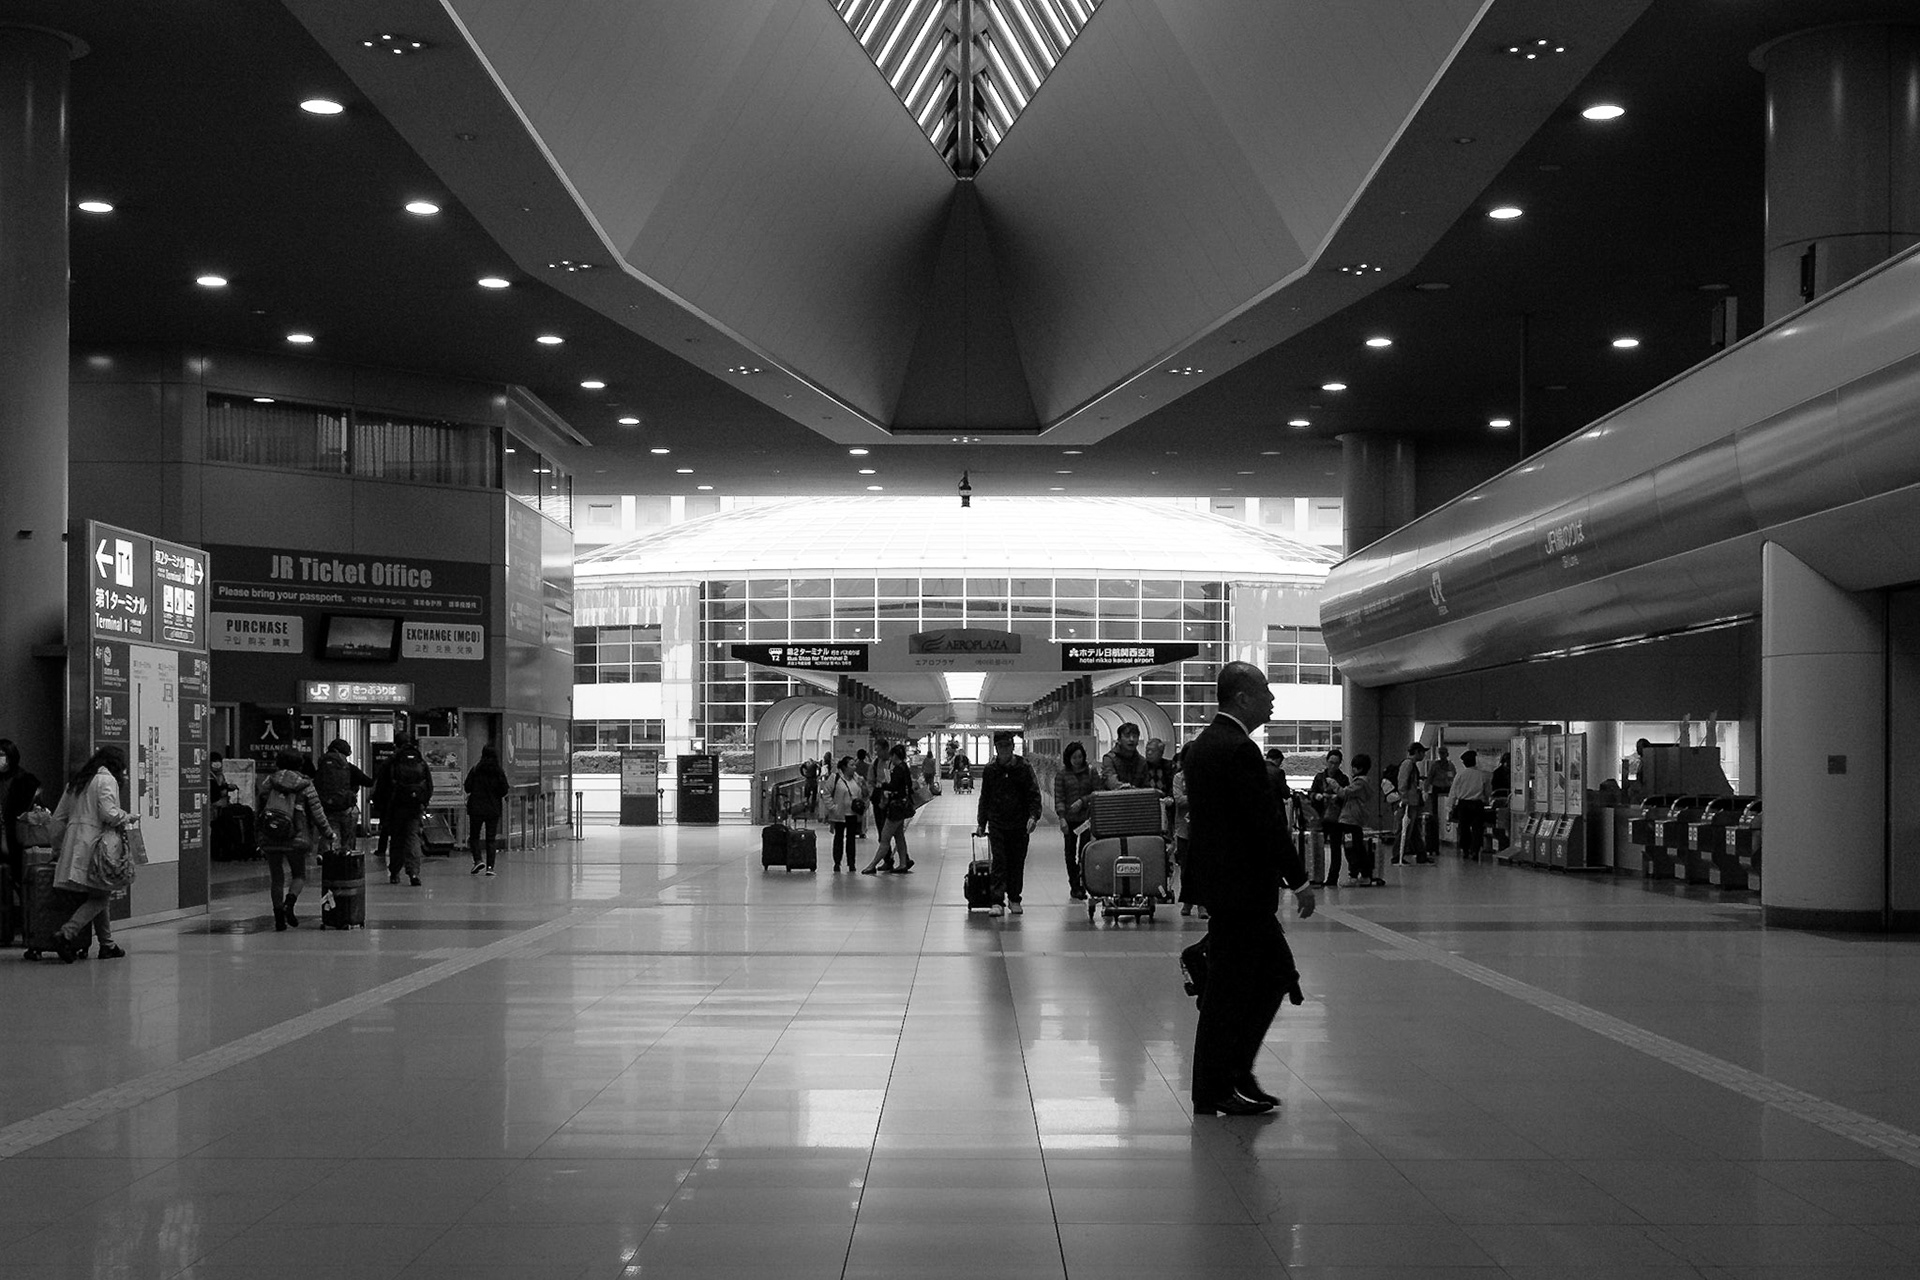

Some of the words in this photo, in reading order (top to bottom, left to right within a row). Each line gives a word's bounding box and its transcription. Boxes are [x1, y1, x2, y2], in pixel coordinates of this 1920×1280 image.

[270, 554, 294, 579] JR
[300, 556, 366, 585] Ticket
[371, 561, 432, 589] Office
[95, 587, 148, 615] 第1ターミナル
[218, 586, 249, 597] Please
[251, 588, 275, 600] bring
[276, 591, 298, 601] your
[299, 592, 345, 604] passports.
[95, 612, 123, 632] Terminal
[124, 618, 128, 633] 1
[226, 619, 288, 635] PURCHASE
[406, 628, 452, 642] EXCHANGE
[945, 639, 1007, 650] AEROPLAZA
[1079, 647, 1155, 657] ホテル日航関西空港
[310, 683, 330, 696] JR
[352, 685, 398, 695] きっぷうりば
[250, 743, 289, 752] ENTRANCE
